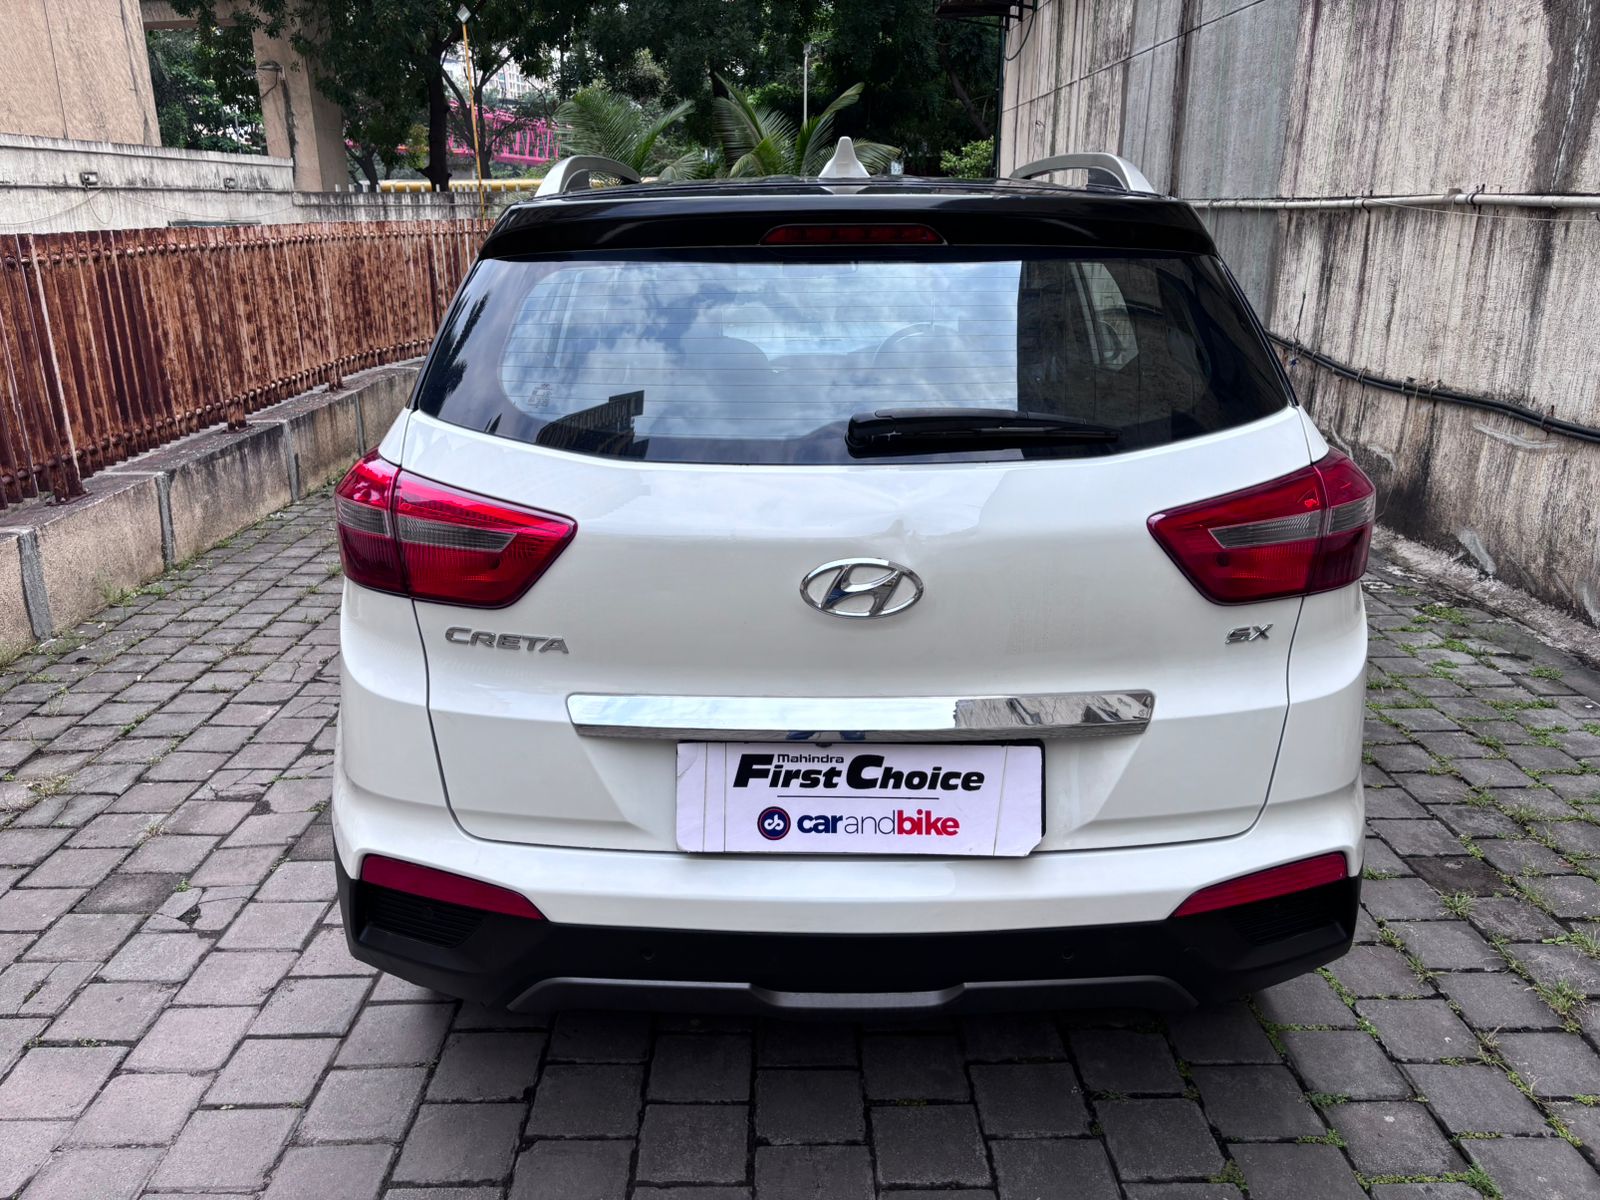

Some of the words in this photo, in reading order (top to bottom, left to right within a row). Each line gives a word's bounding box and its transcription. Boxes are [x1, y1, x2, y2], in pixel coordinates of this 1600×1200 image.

[445, 626, 569, 654] CRETA
[1225, 624, 1273, 644] SX
[777, 754, 844, 763] Mahindra
[733, 754, 842, 788] First
[846, 755, 984, 791] Choice
[797, 809, 960, 836] carandbike
